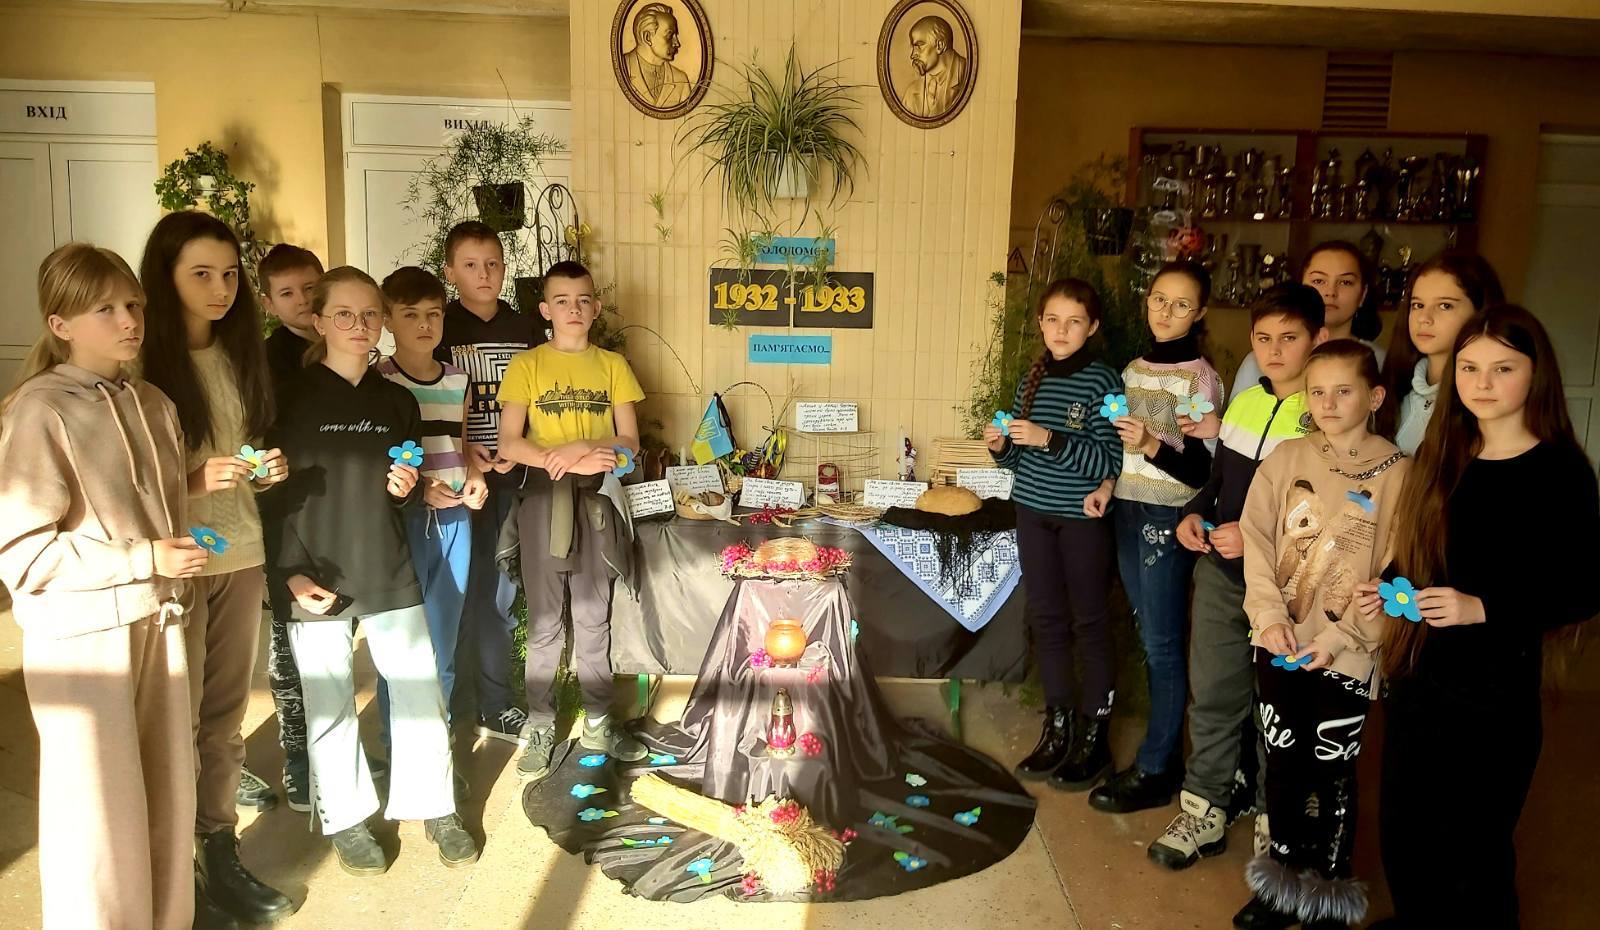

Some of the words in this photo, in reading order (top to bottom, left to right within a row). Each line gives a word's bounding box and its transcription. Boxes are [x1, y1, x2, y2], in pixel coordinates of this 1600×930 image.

[26, 105, 67, 120] ВХІД
[713, 281, 778, 311] 1932
[800, 284, 866, 314] 1933
[319, 423, 348, 432] come
[347, 418, 374, 433] with
[374, 424, 391, 434] me
